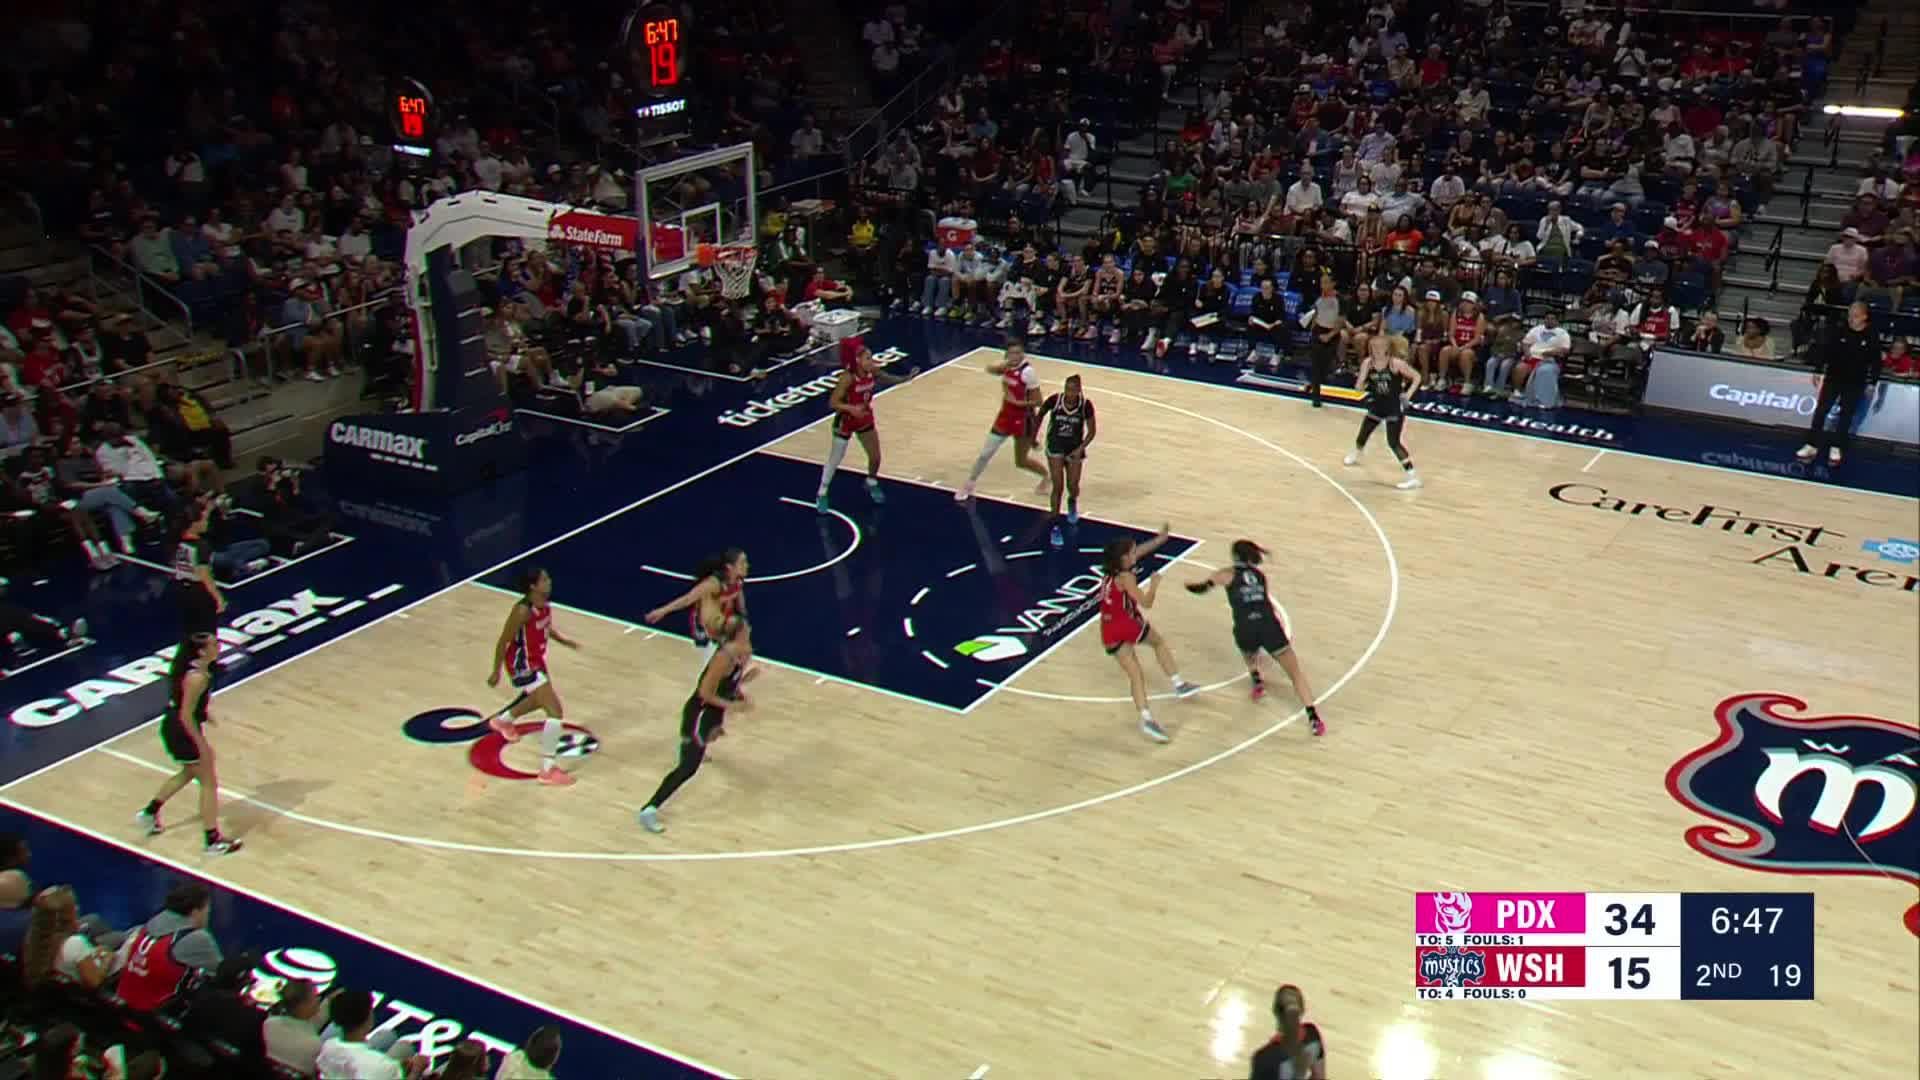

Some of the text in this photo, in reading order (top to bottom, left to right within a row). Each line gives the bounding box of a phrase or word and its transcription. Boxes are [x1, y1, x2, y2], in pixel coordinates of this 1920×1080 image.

[643, 19, 678, 45] 6:47
[651, 43, 678, 87] 19
[718, 346, 910, 427] ticketmer
[1710, 384, 1817, 415] CapitalO
[1502, 414, 1615, 441] Health
[1548, 483, 1847, 547] CareFirst
[996, 564, 1105, 634] VAND
[366, 991, 518, 1073] T&T
